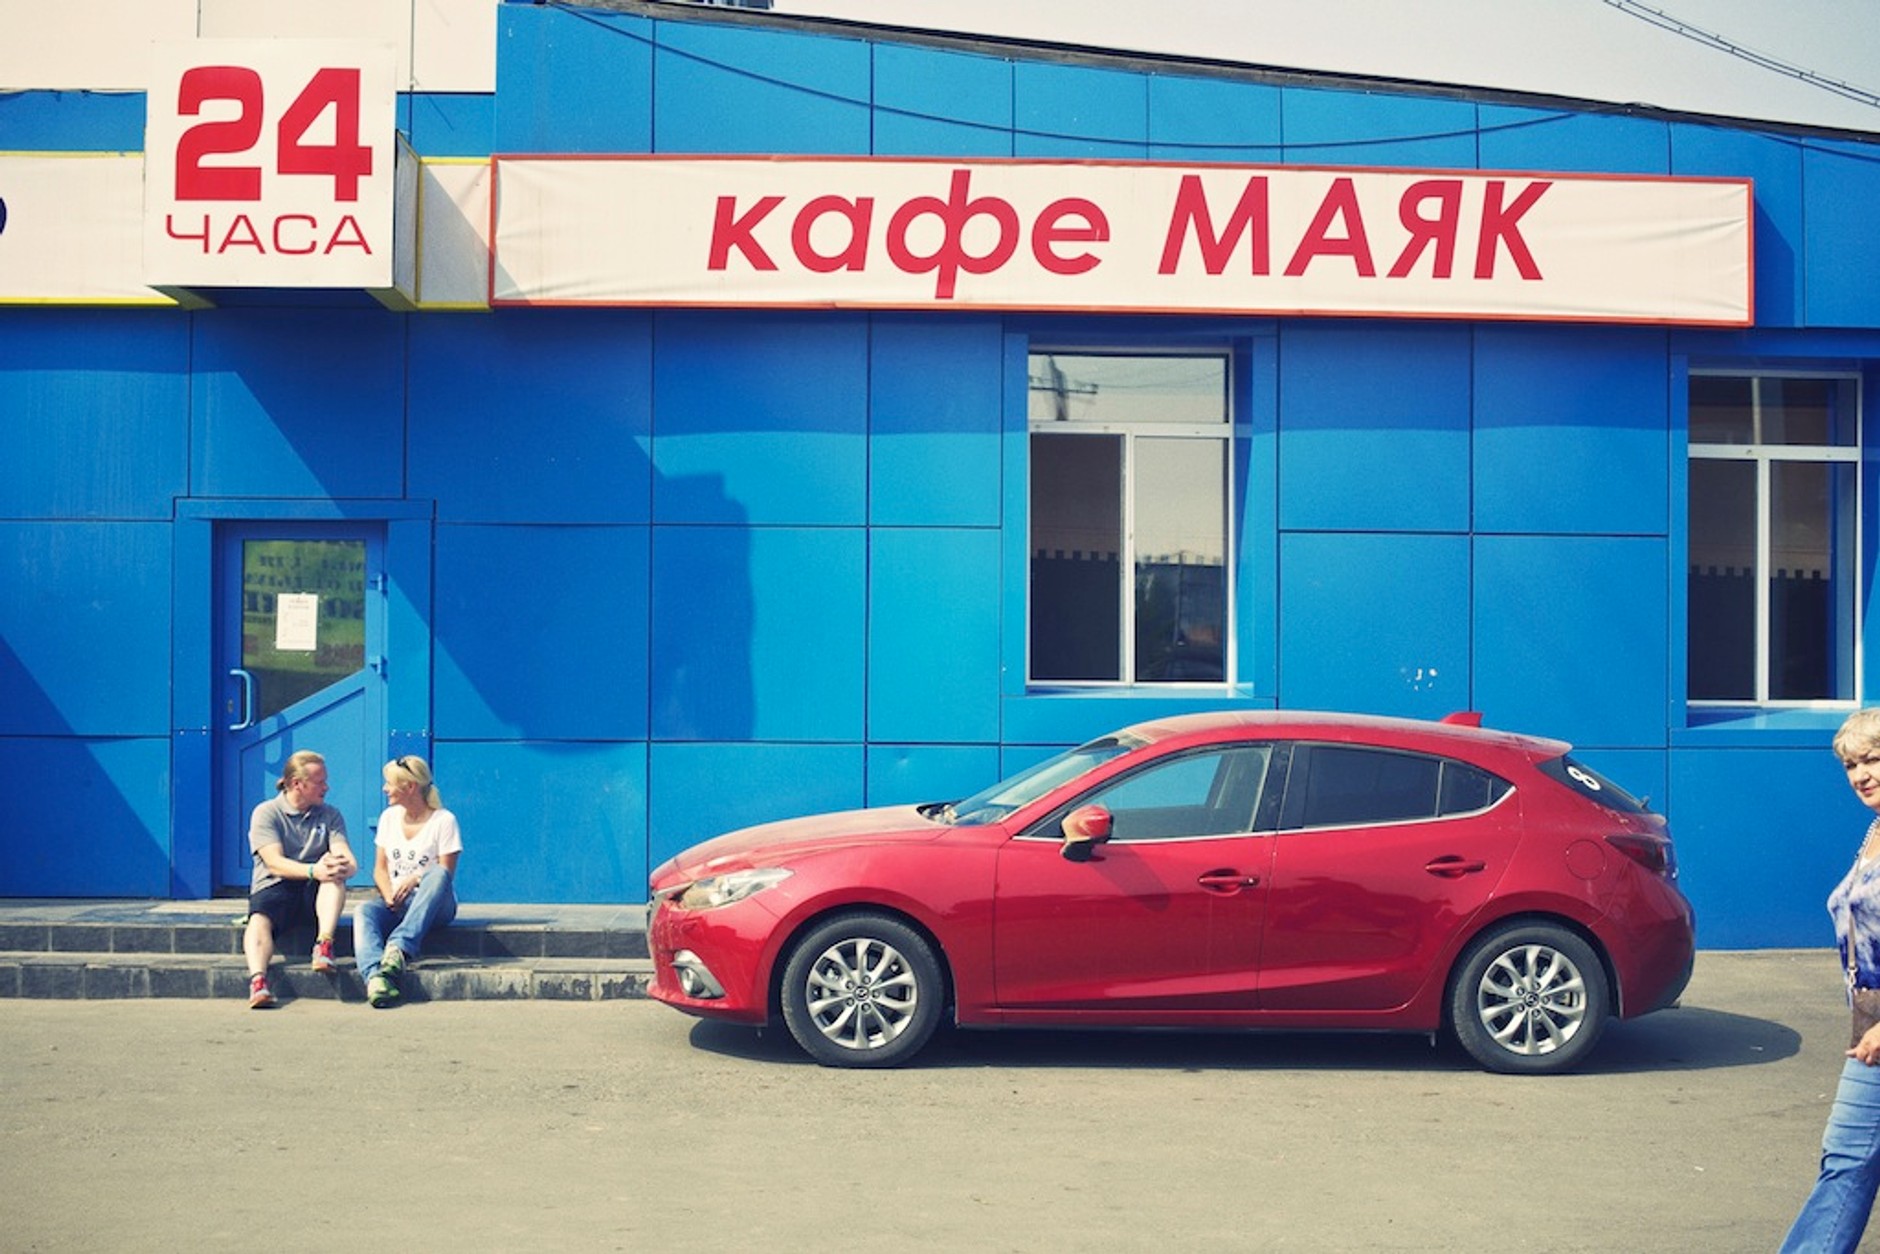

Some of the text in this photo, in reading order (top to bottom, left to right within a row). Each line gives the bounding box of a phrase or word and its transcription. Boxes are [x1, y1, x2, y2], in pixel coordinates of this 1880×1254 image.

[174, 65, 374, 202] 24
[166, 214, 372, 255] ЧАСА
[707, 168, 1552, 300] кафе МАЯК
[1567, 766, 1601, 791] 8
